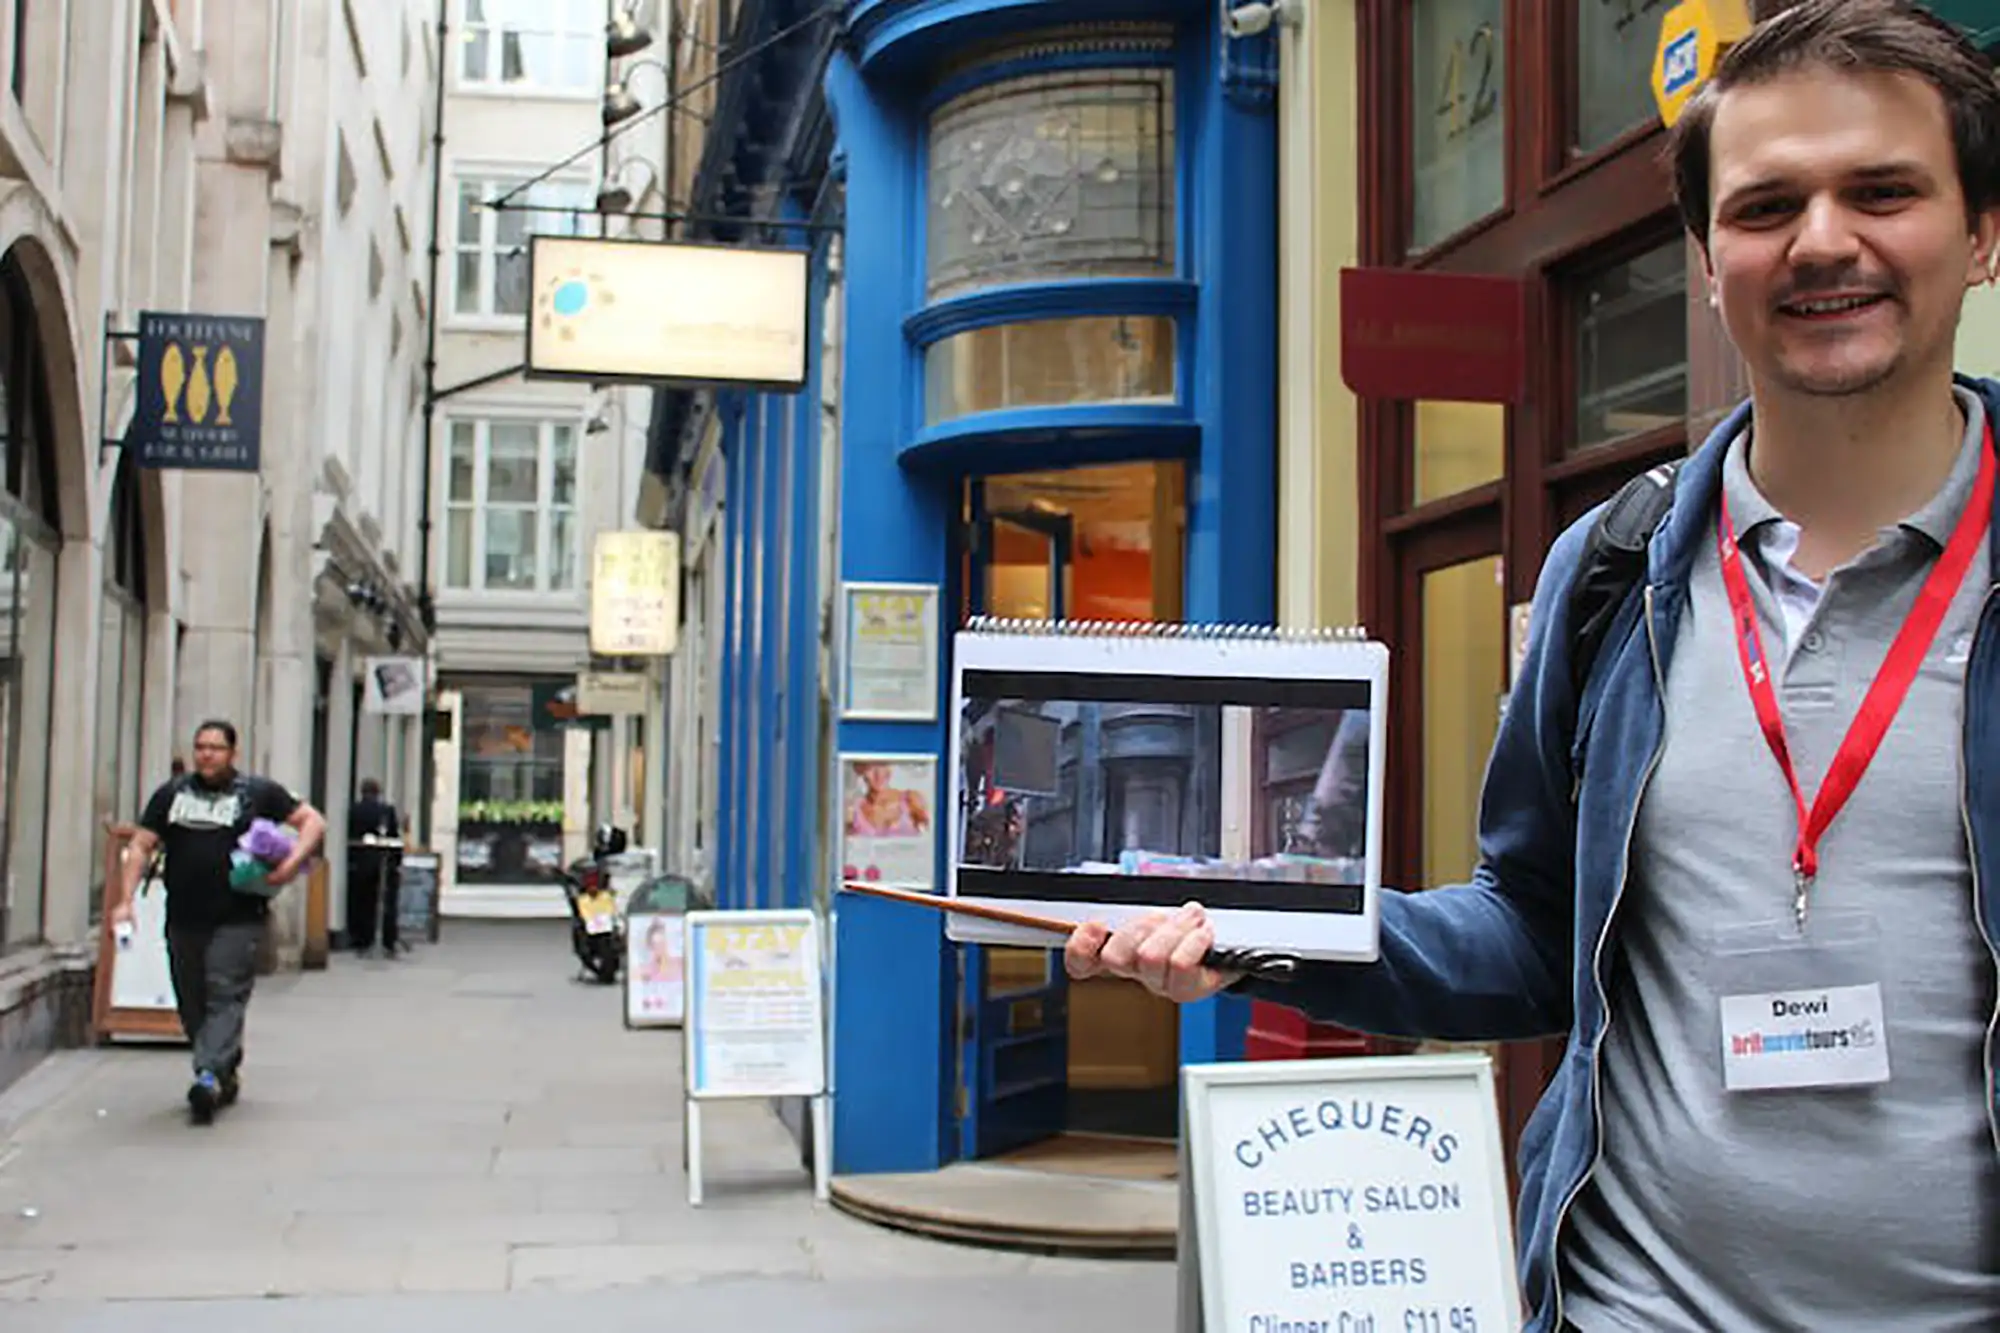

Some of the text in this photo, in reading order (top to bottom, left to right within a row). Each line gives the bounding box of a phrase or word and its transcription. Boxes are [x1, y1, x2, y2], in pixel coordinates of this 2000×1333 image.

[1772, 994, 1828, 1016] Dewi
[1235, 1100, 1459, 1168] CHEQUERS
[1243, 1184, 1461, 1216] BEAUTY SALON
[1346, 1222, 1363, 1250] &
[1290, 1258, 1427, 1289] BARBERS
[1403, 1306, 1477, 1333] £1195
